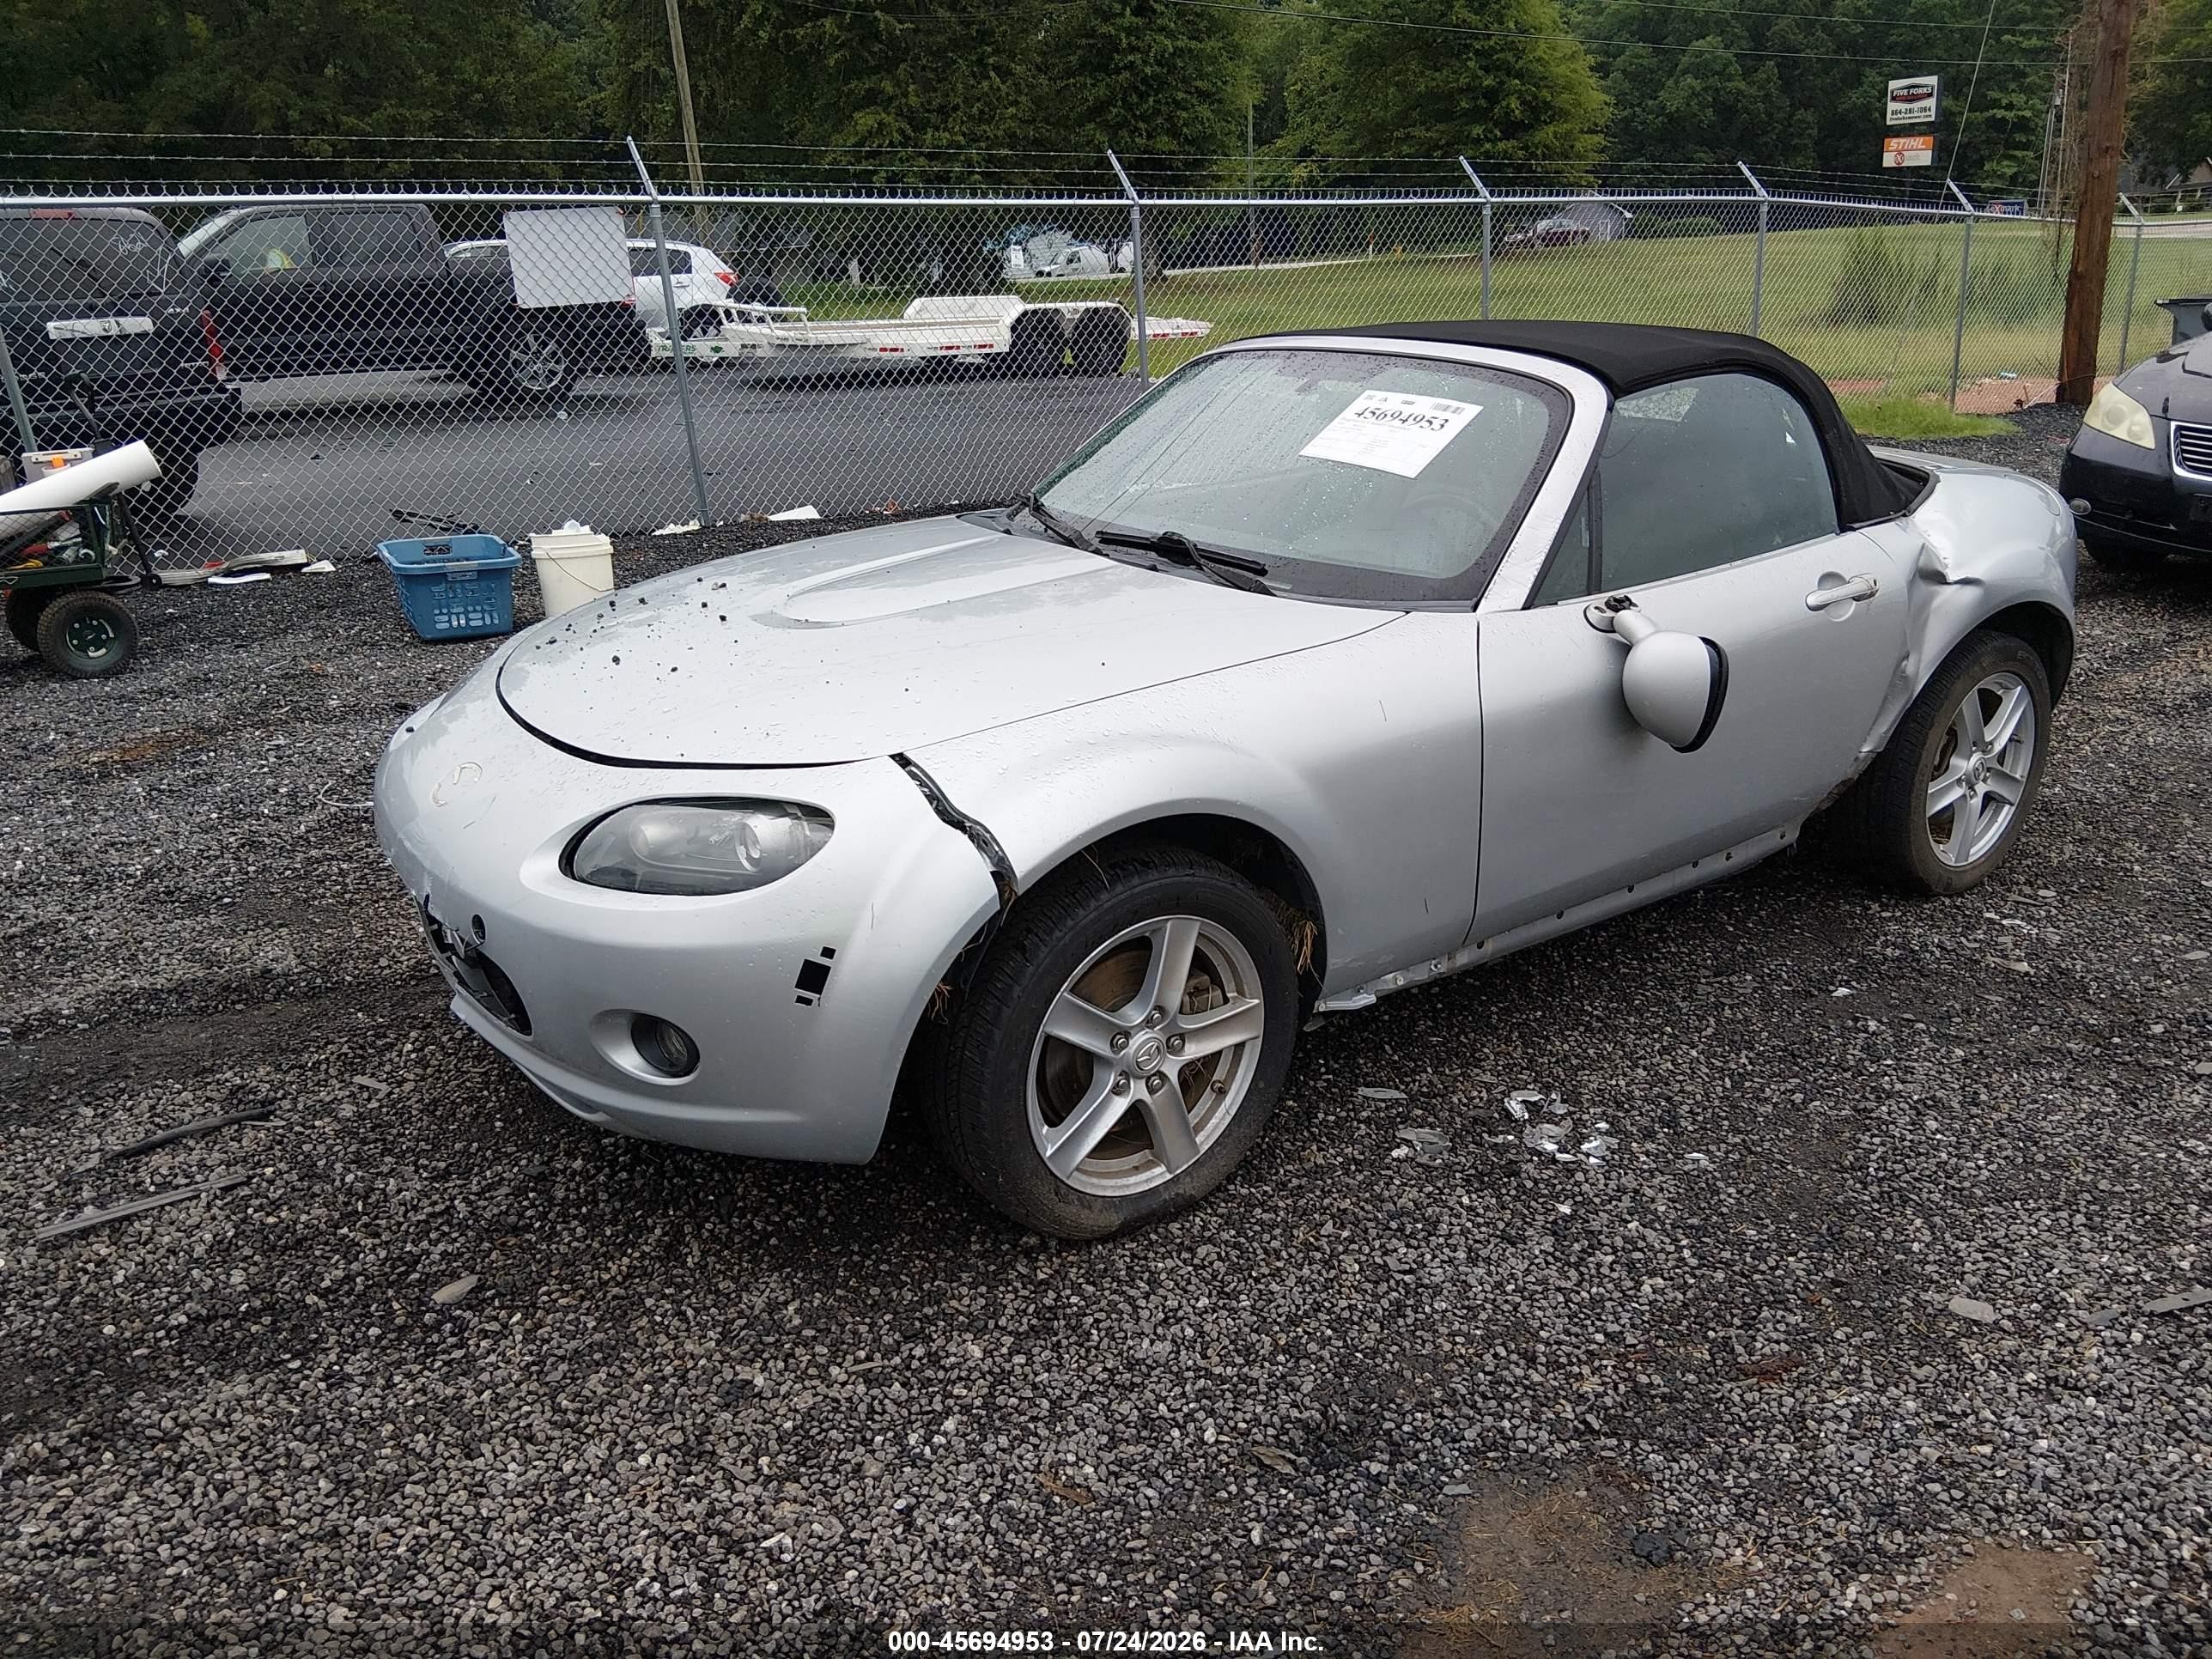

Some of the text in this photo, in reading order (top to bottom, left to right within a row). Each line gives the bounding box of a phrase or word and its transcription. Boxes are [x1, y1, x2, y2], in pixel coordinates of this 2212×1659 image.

[1893, 87, 1932, 97] FIVE FORKS
[1890, 106, 1932, 117] 864-281-1064
[1888, 137, 1926, 150] STIHL
[1354, 406, 1449, 432] 45694953
